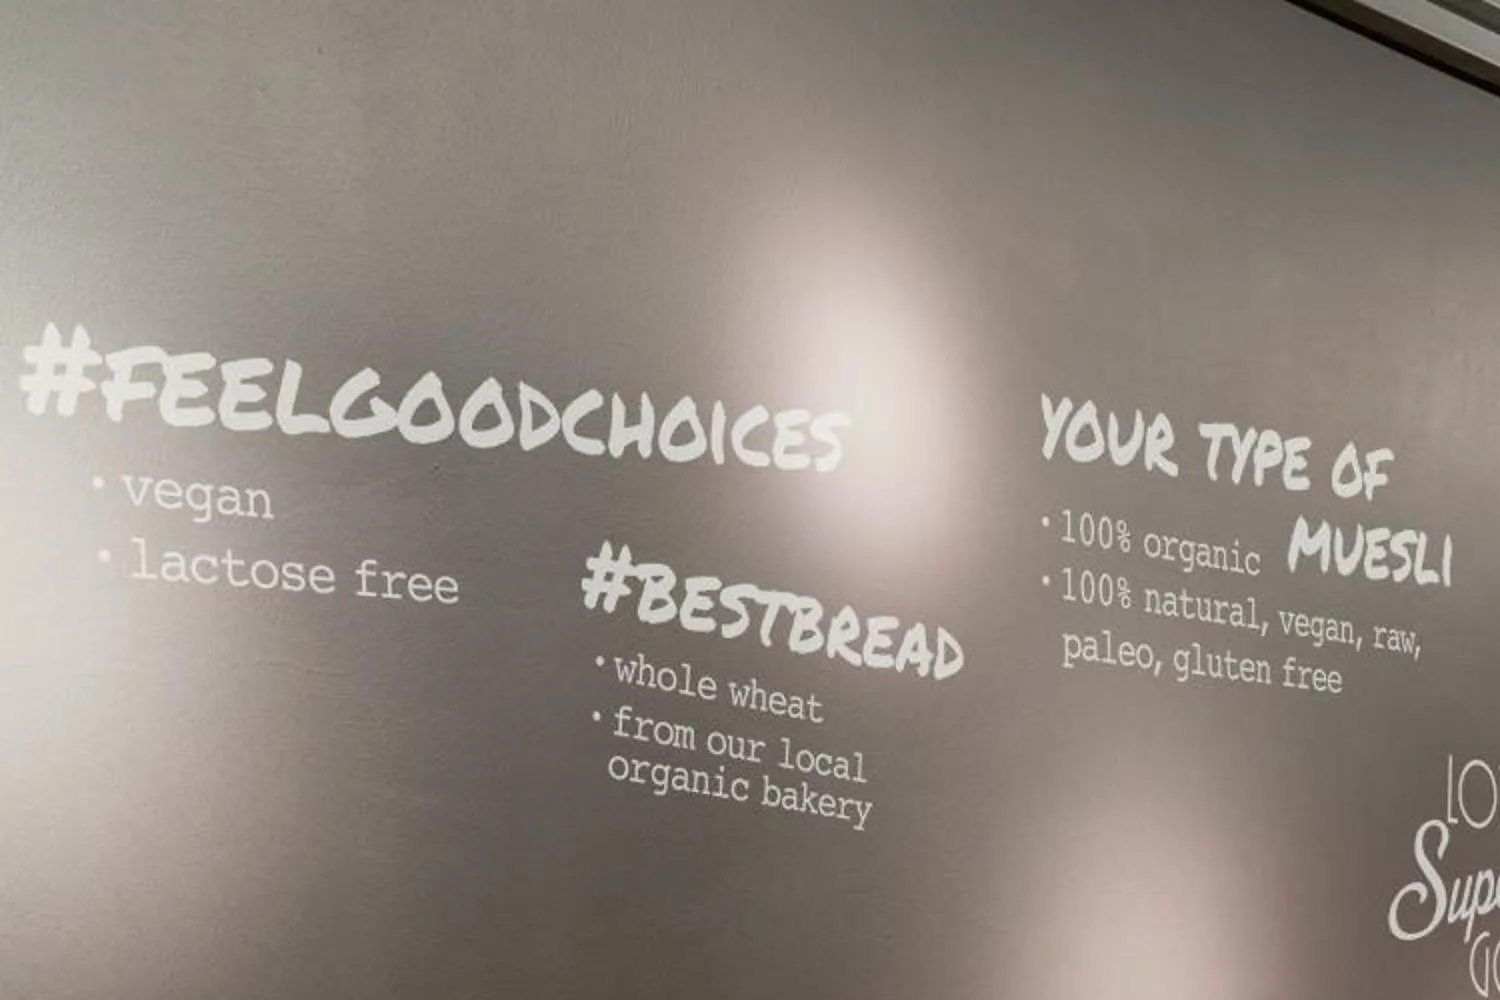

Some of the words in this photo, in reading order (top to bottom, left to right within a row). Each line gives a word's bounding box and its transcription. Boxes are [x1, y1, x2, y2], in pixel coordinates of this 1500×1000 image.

[18, 321, 851, 473] #FEELGOODCHOICES
[1041, 393, 1179, 477] YOUR
[1198, 422, 1312, 491] TYPE
[1331, 441, 1395, 501] OF
[123, 475, 275, 523] vegan
[131, 538, 336, 595] lactose
[355, 559, 460, 605] free
[1061, 509, 1131, 553] 100%
[1143, 530, 1261, 576] organic
[1287, 515, 1453, 588] MUESLI
[581, 540, 966, 680] #BESTBREAD
[1062, 567, 1132, 609] 100%
[1144, 588, 1270, 637] natural,
[1278, 608, 1363, 652] vegan,
[1372, 625, 1422, 661] raw,
[614, 652, 718, 702] whole
[728, 677, 824, 723] wheat
[1062, 629, 1163, 677] paleo,
[1173, 642, 1272, 685] gluten
[1282, 656, 1343, 694] free
[613, 705, 697, 752] from
[706, 730, 766, 763] our
[779, 737, 868, 786] local
[607, 750, 750, 803] organic
[761, 779, 873, 831] bakery
